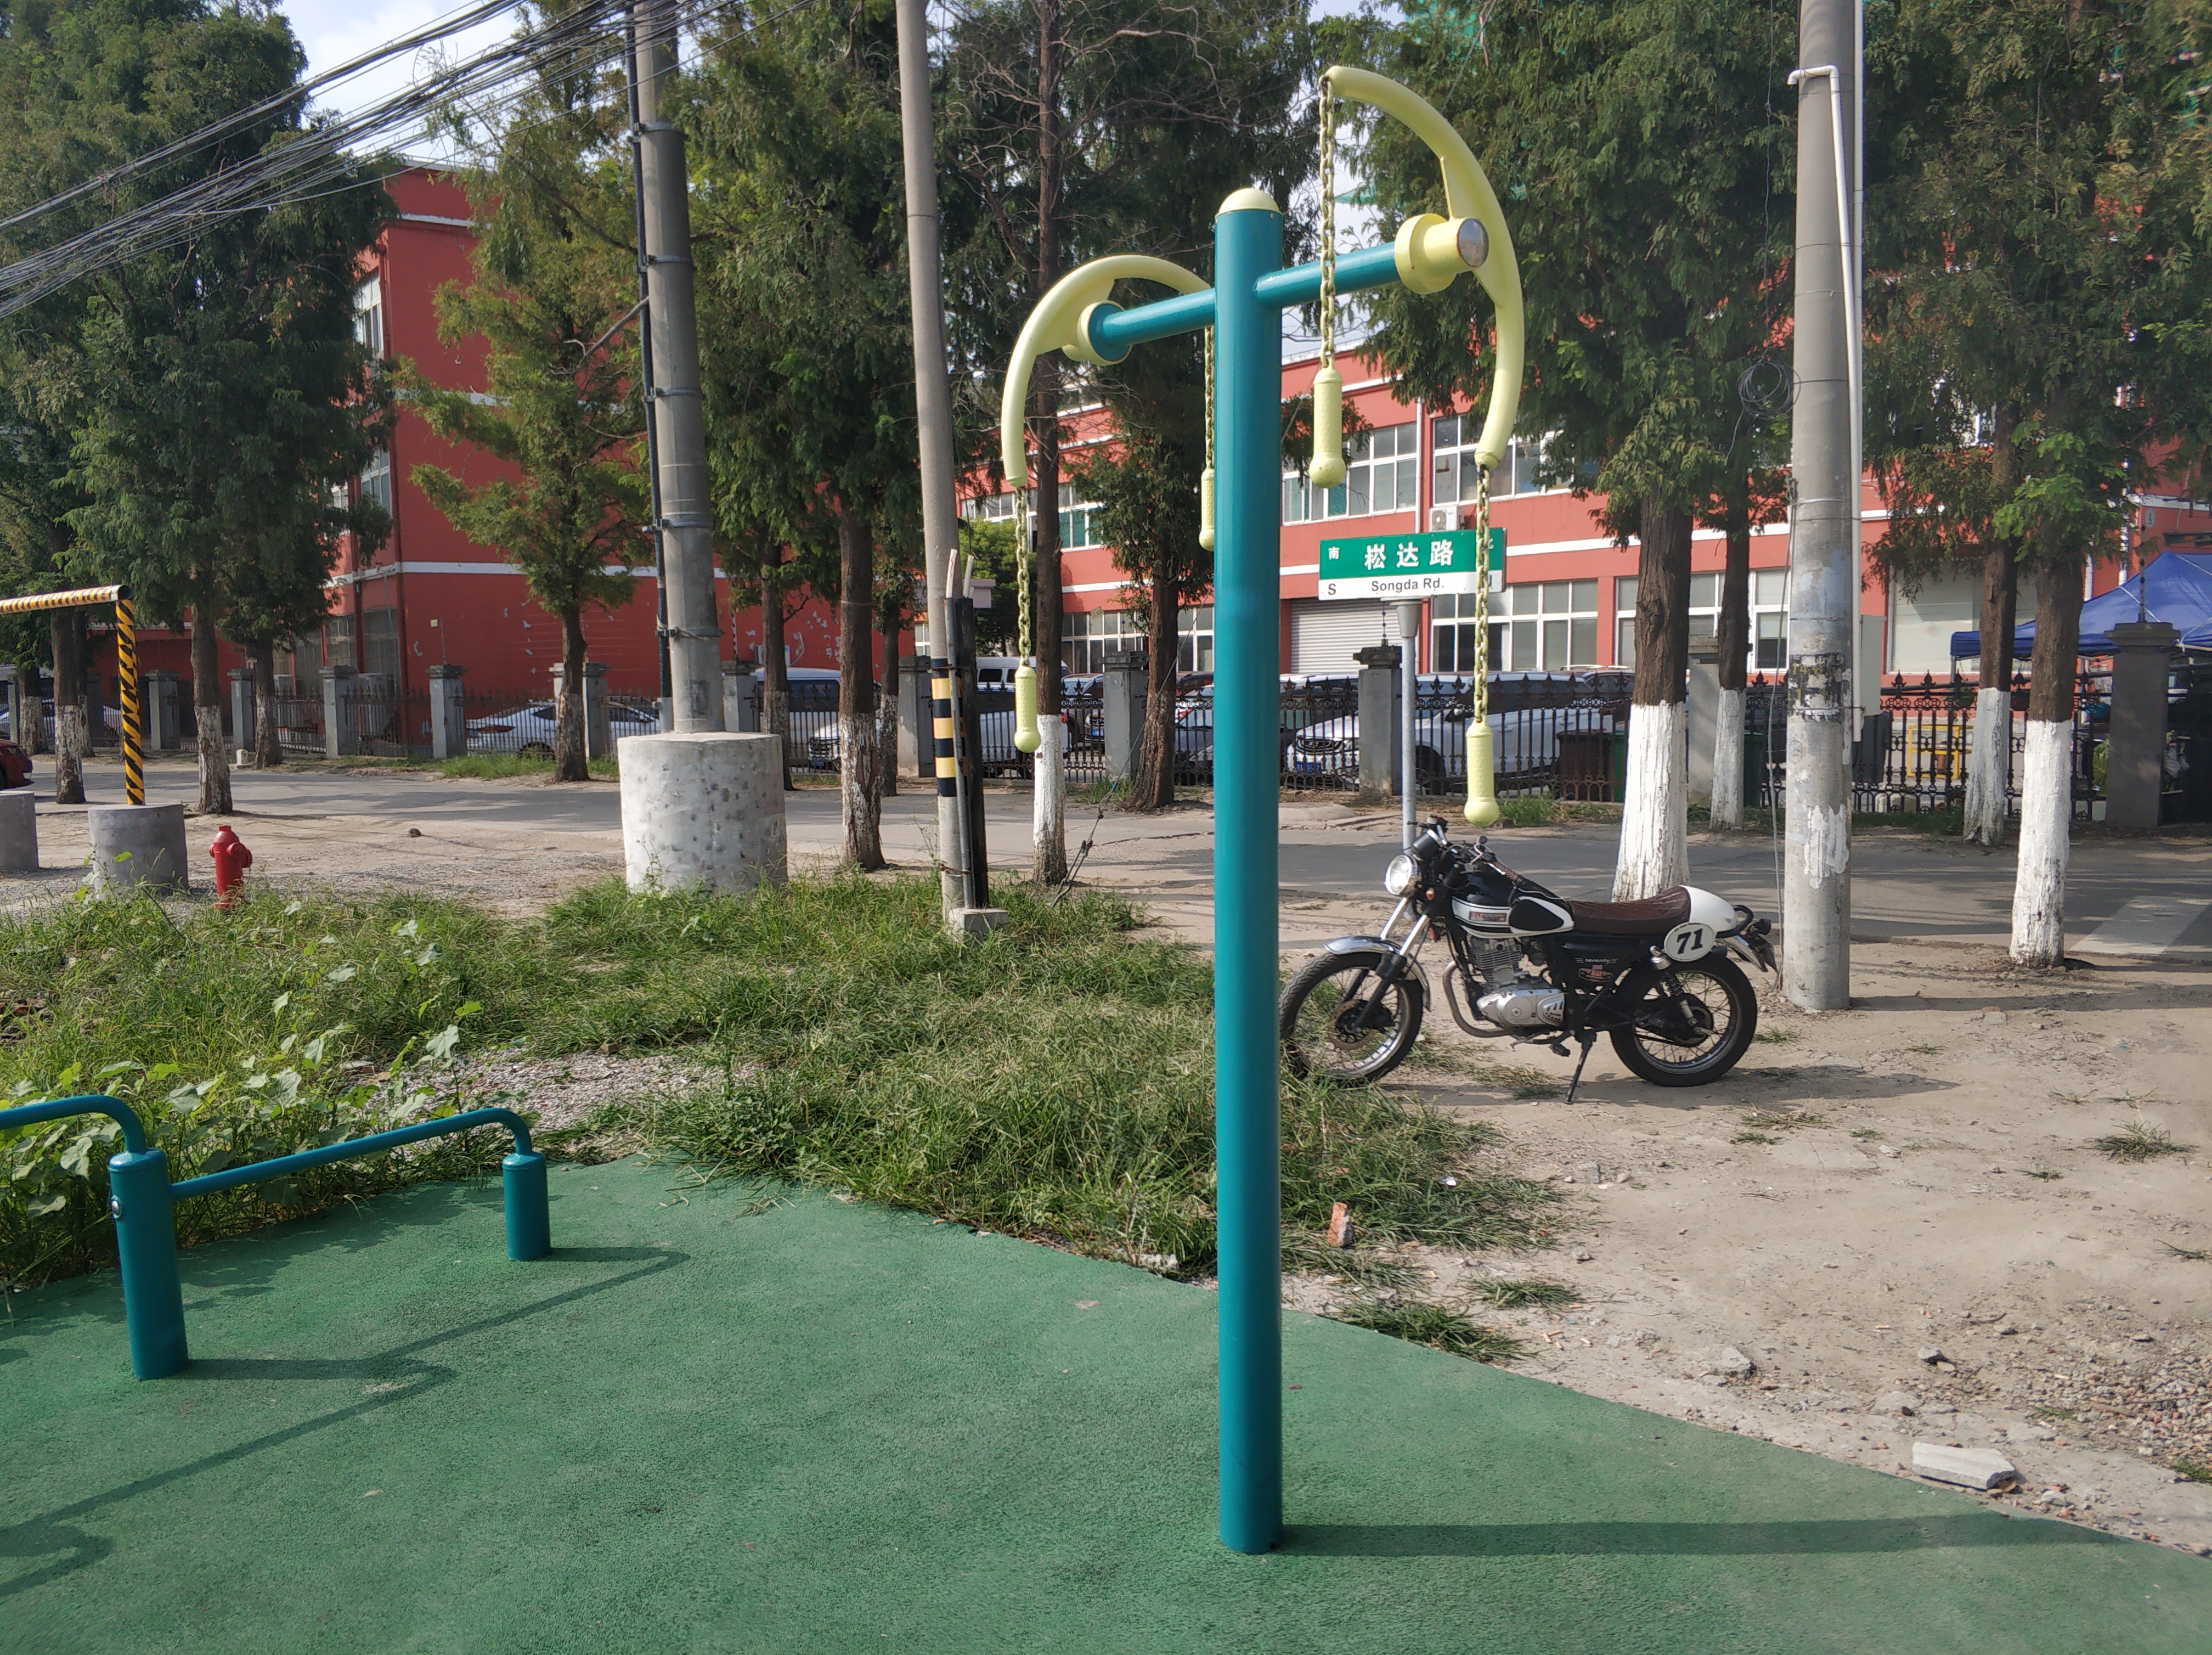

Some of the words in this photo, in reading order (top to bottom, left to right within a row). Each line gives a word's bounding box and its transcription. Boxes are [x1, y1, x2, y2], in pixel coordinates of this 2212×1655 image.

[1328, 546, 1340, 560] 南
[1364, 539, 1453, 570] 崧达路
[1328, 583, 1336, 595] S
[1372, 579, 1418, 593] Songda
[1423, 578, 1444, 589] Rd.
[1676, 928, 1703, 955] 71
